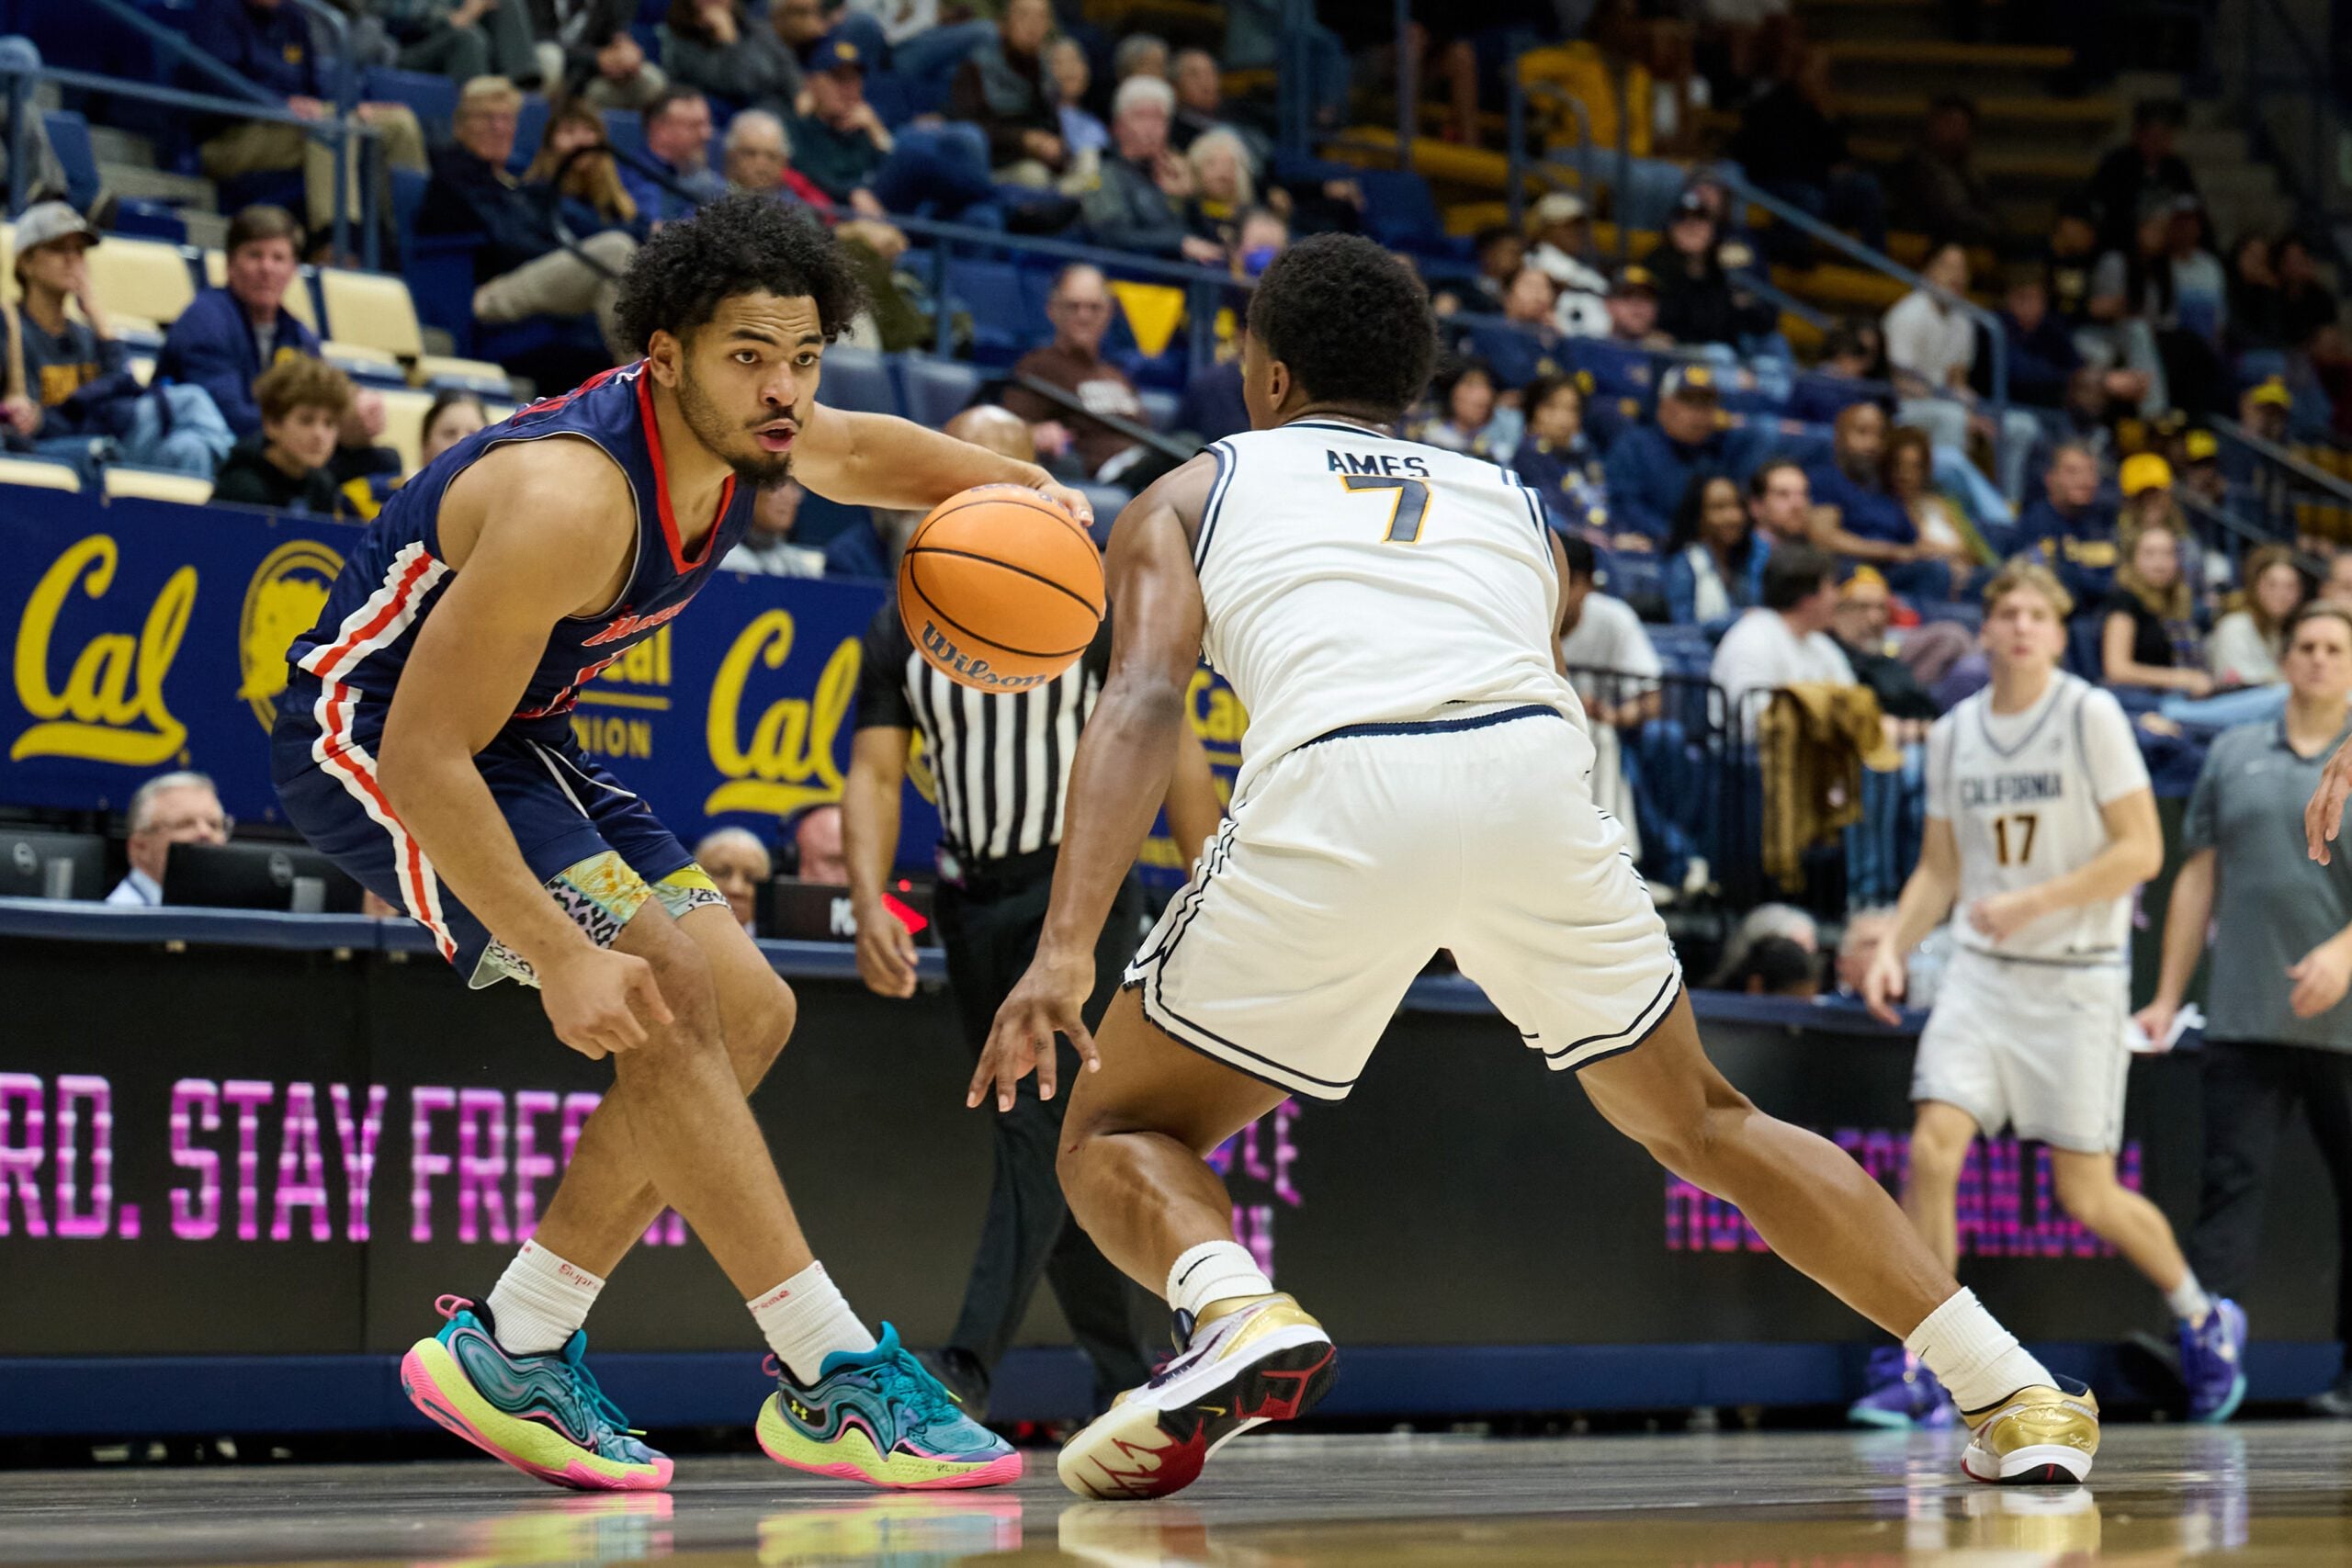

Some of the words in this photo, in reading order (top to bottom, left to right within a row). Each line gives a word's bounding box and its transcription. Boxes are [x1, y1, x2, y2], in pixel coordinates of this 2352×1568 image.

[1326, 448, 1430, 478] AMES
[1339, 474, 1433, 544] 7
[10, 533, 198, 766] Cal
[922, 620, 1046, 687] Wilson
[570, 715, 651, 759] NION
[704, 608, 862, 816] Cal
[1994, 813, 2039, 865] 17
[0, 1072, 141, 1239] RD.
[169, 1077, 387, 1241] STAY
[412, 1086, 686, 1247] FRE
